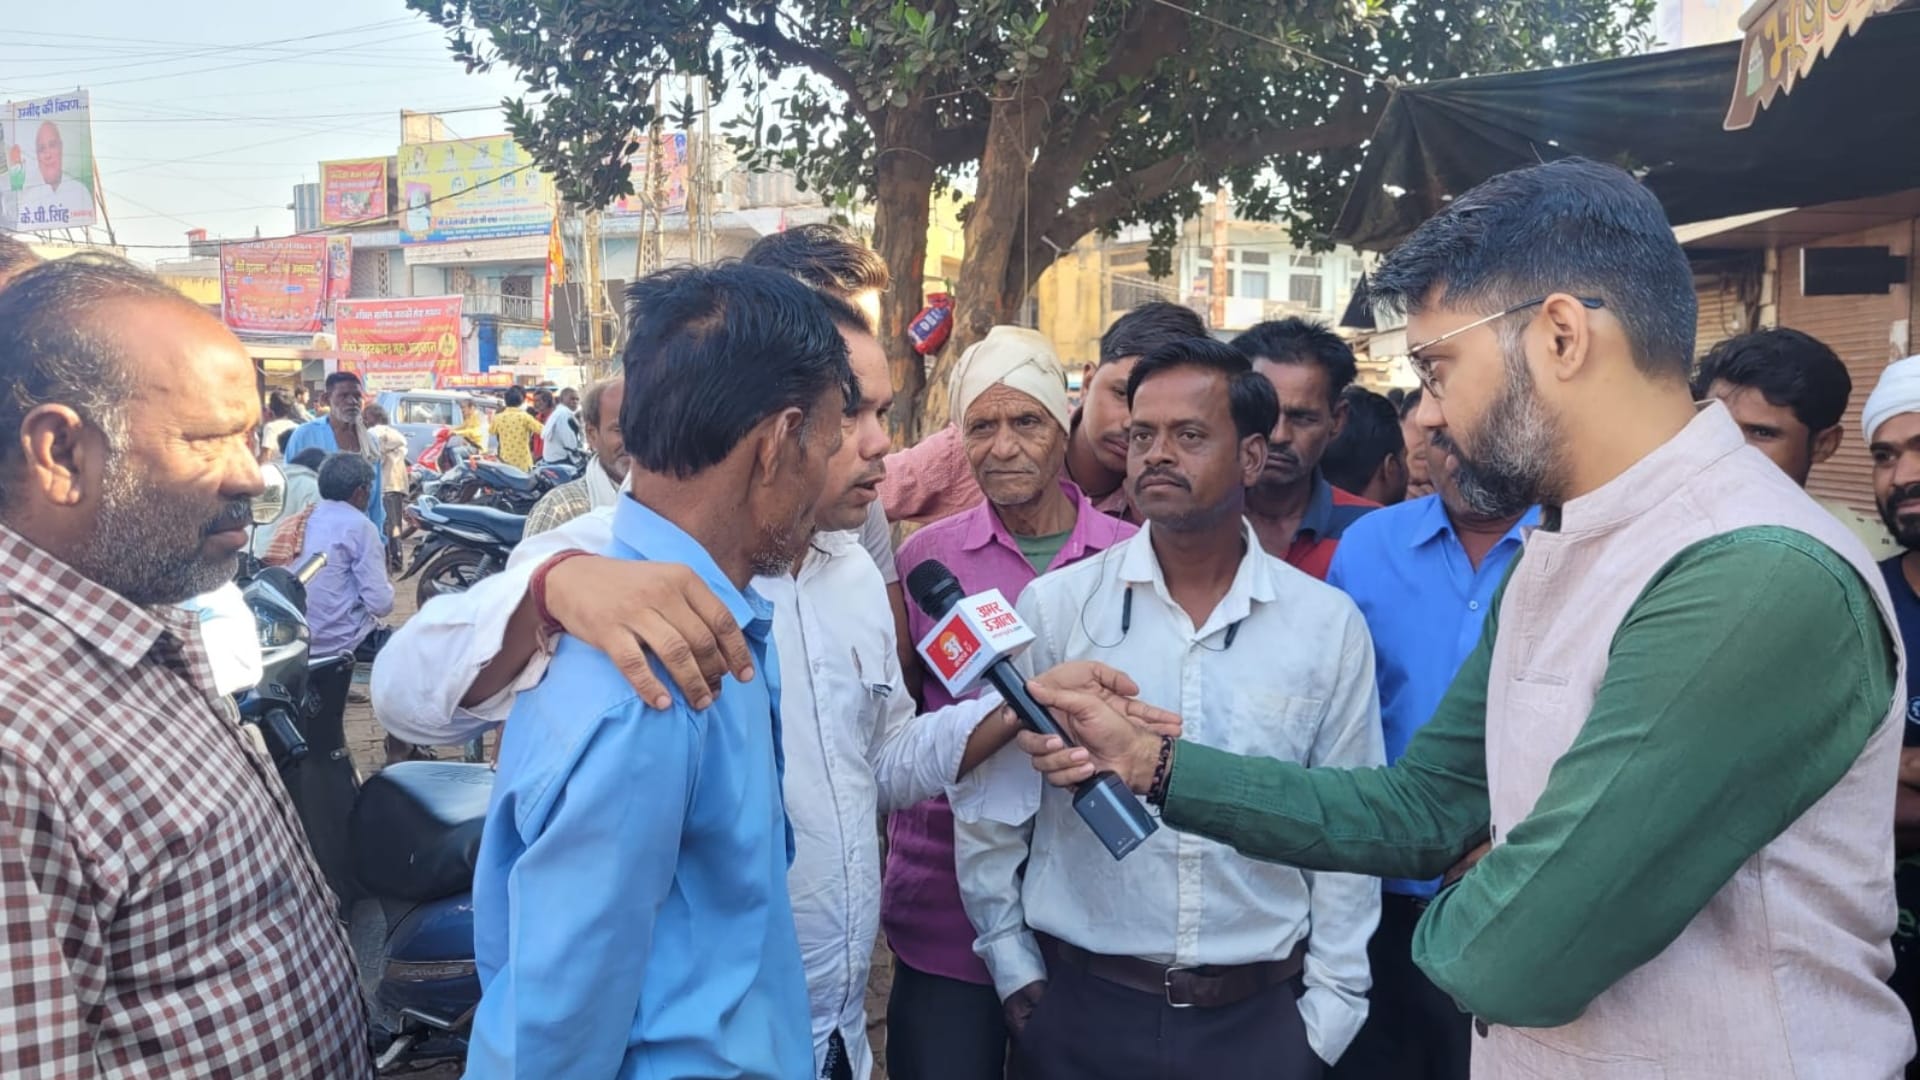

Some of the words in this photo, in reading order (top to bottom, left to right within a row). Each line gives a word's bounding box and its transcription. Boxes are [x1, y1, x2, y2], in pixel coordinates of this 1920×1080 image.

[42, 99, 54, 114] की
[976, 602, 1004, 618] अमर
[981, 612, 1018, 632] उजाला
